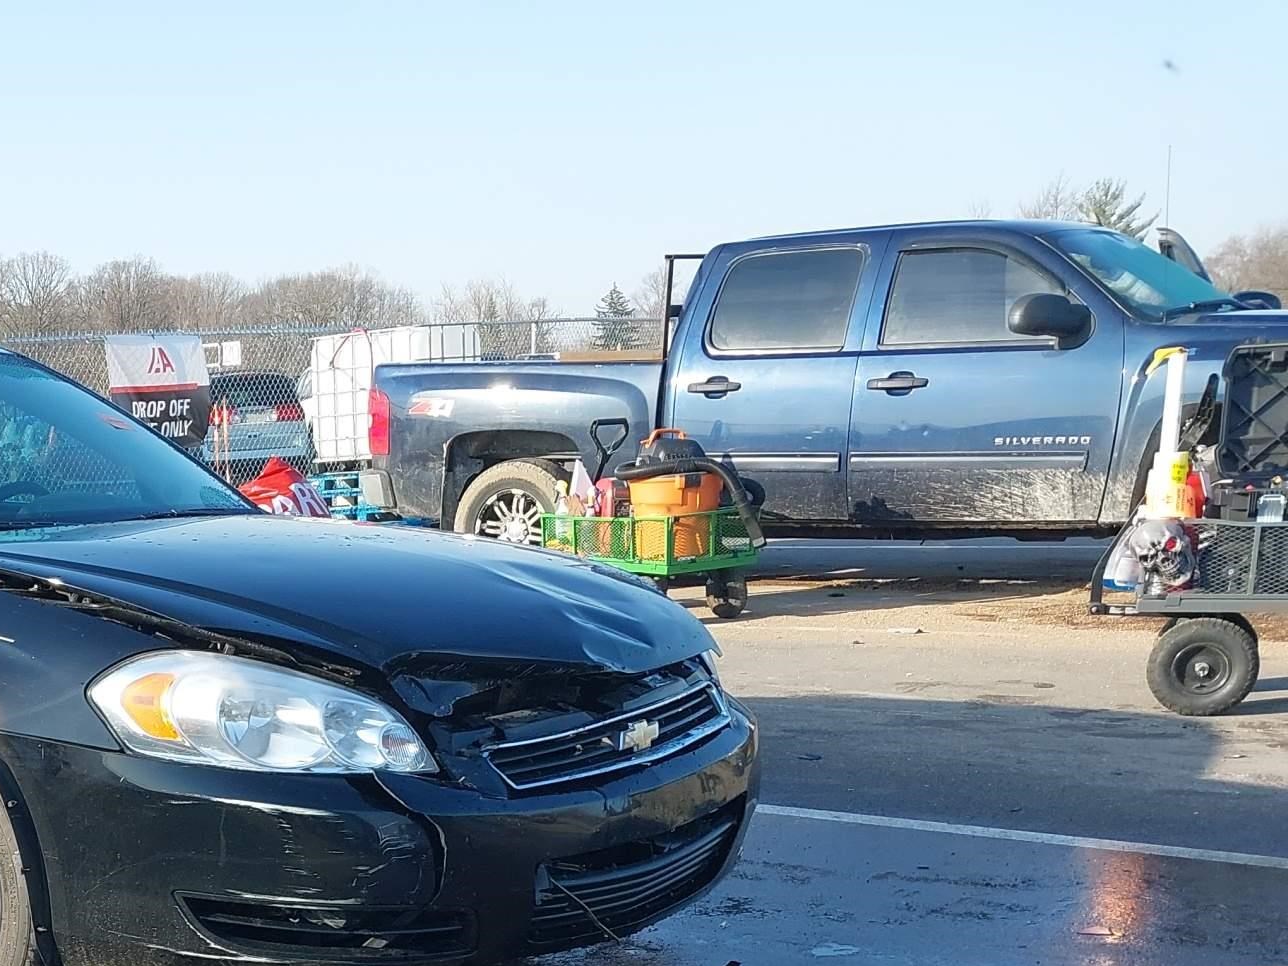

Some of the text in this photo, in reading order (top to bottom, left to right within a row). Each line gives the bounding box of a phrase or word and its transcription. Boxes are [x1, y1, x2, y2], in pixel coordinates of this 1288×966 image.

[132, 398, 191, 418] DROP OFF
[161, 420, 193, 438] ONLY
[993, 436, 1092, 446] SILVERADO
